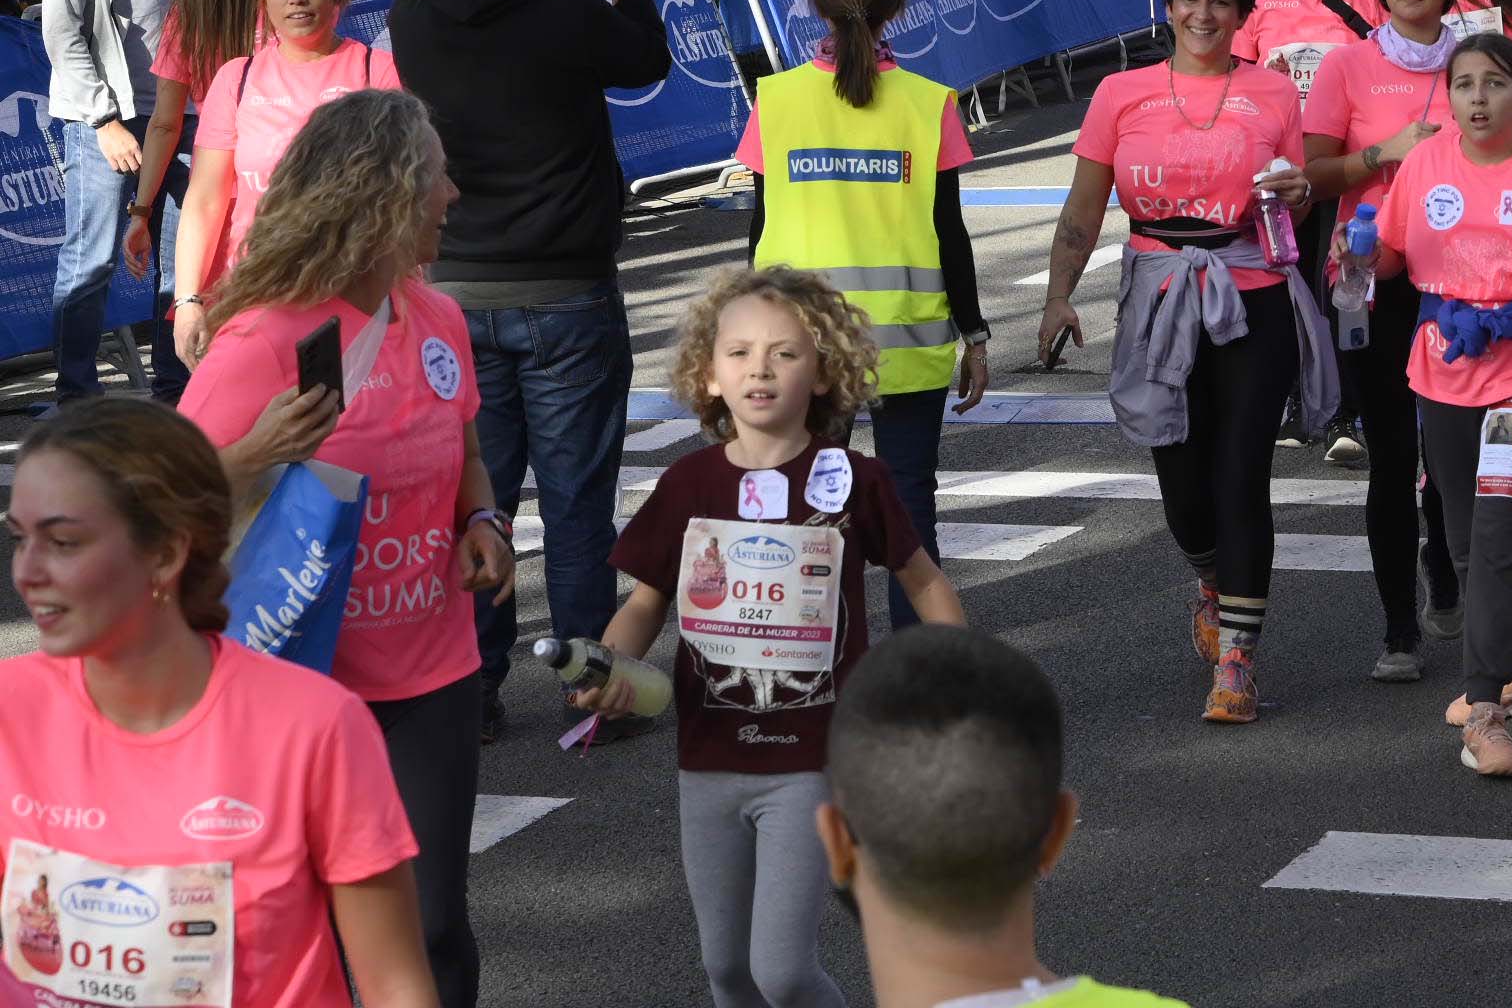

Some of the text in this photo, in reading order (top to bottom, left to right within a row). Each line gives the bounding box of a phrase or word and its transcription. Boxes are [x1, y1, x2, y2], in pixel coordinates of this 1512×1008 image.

[1264, 1, 1300, 10] OYSHO
[1293, 69, 1317, 80] 01
[1371, 84, 1414, 96] OYSHO
[1141, 96, 1186, 111] OYSHO
[790, 157, 899, 175] VOLUNTARIS
[240, 171, 270, 192] TU
[1130, 166, 1163, 188] TU
[1136, 196, 1238, 225] DORSAL
[1426, 324, 1447, 351] SU
[362, 372, 392, 390] SHO
[366, 493, 389, 525] U
[733, 548, 792, 563] ASTURIANA
[801, 545, 832, 556] SUMA
[344, 574, 446, 618] SUMA
[732, 580, 785, 603] 016
[739, 607, 773, 622] 8247
[694, 621, 736, 634] CARRERA
[737, 625, 749, 635] DE
[751, 626, 764, 636] LA
[765, 627, 798, 639] MUJER
[775, 648, 822, 660] Santander
[11, 793, 107, 831] OYSHO
[69, 892, 151, 918] ASTURIANA
[69, 941, 146, 975] 016
[78, 980, 137, 1002] 19456
